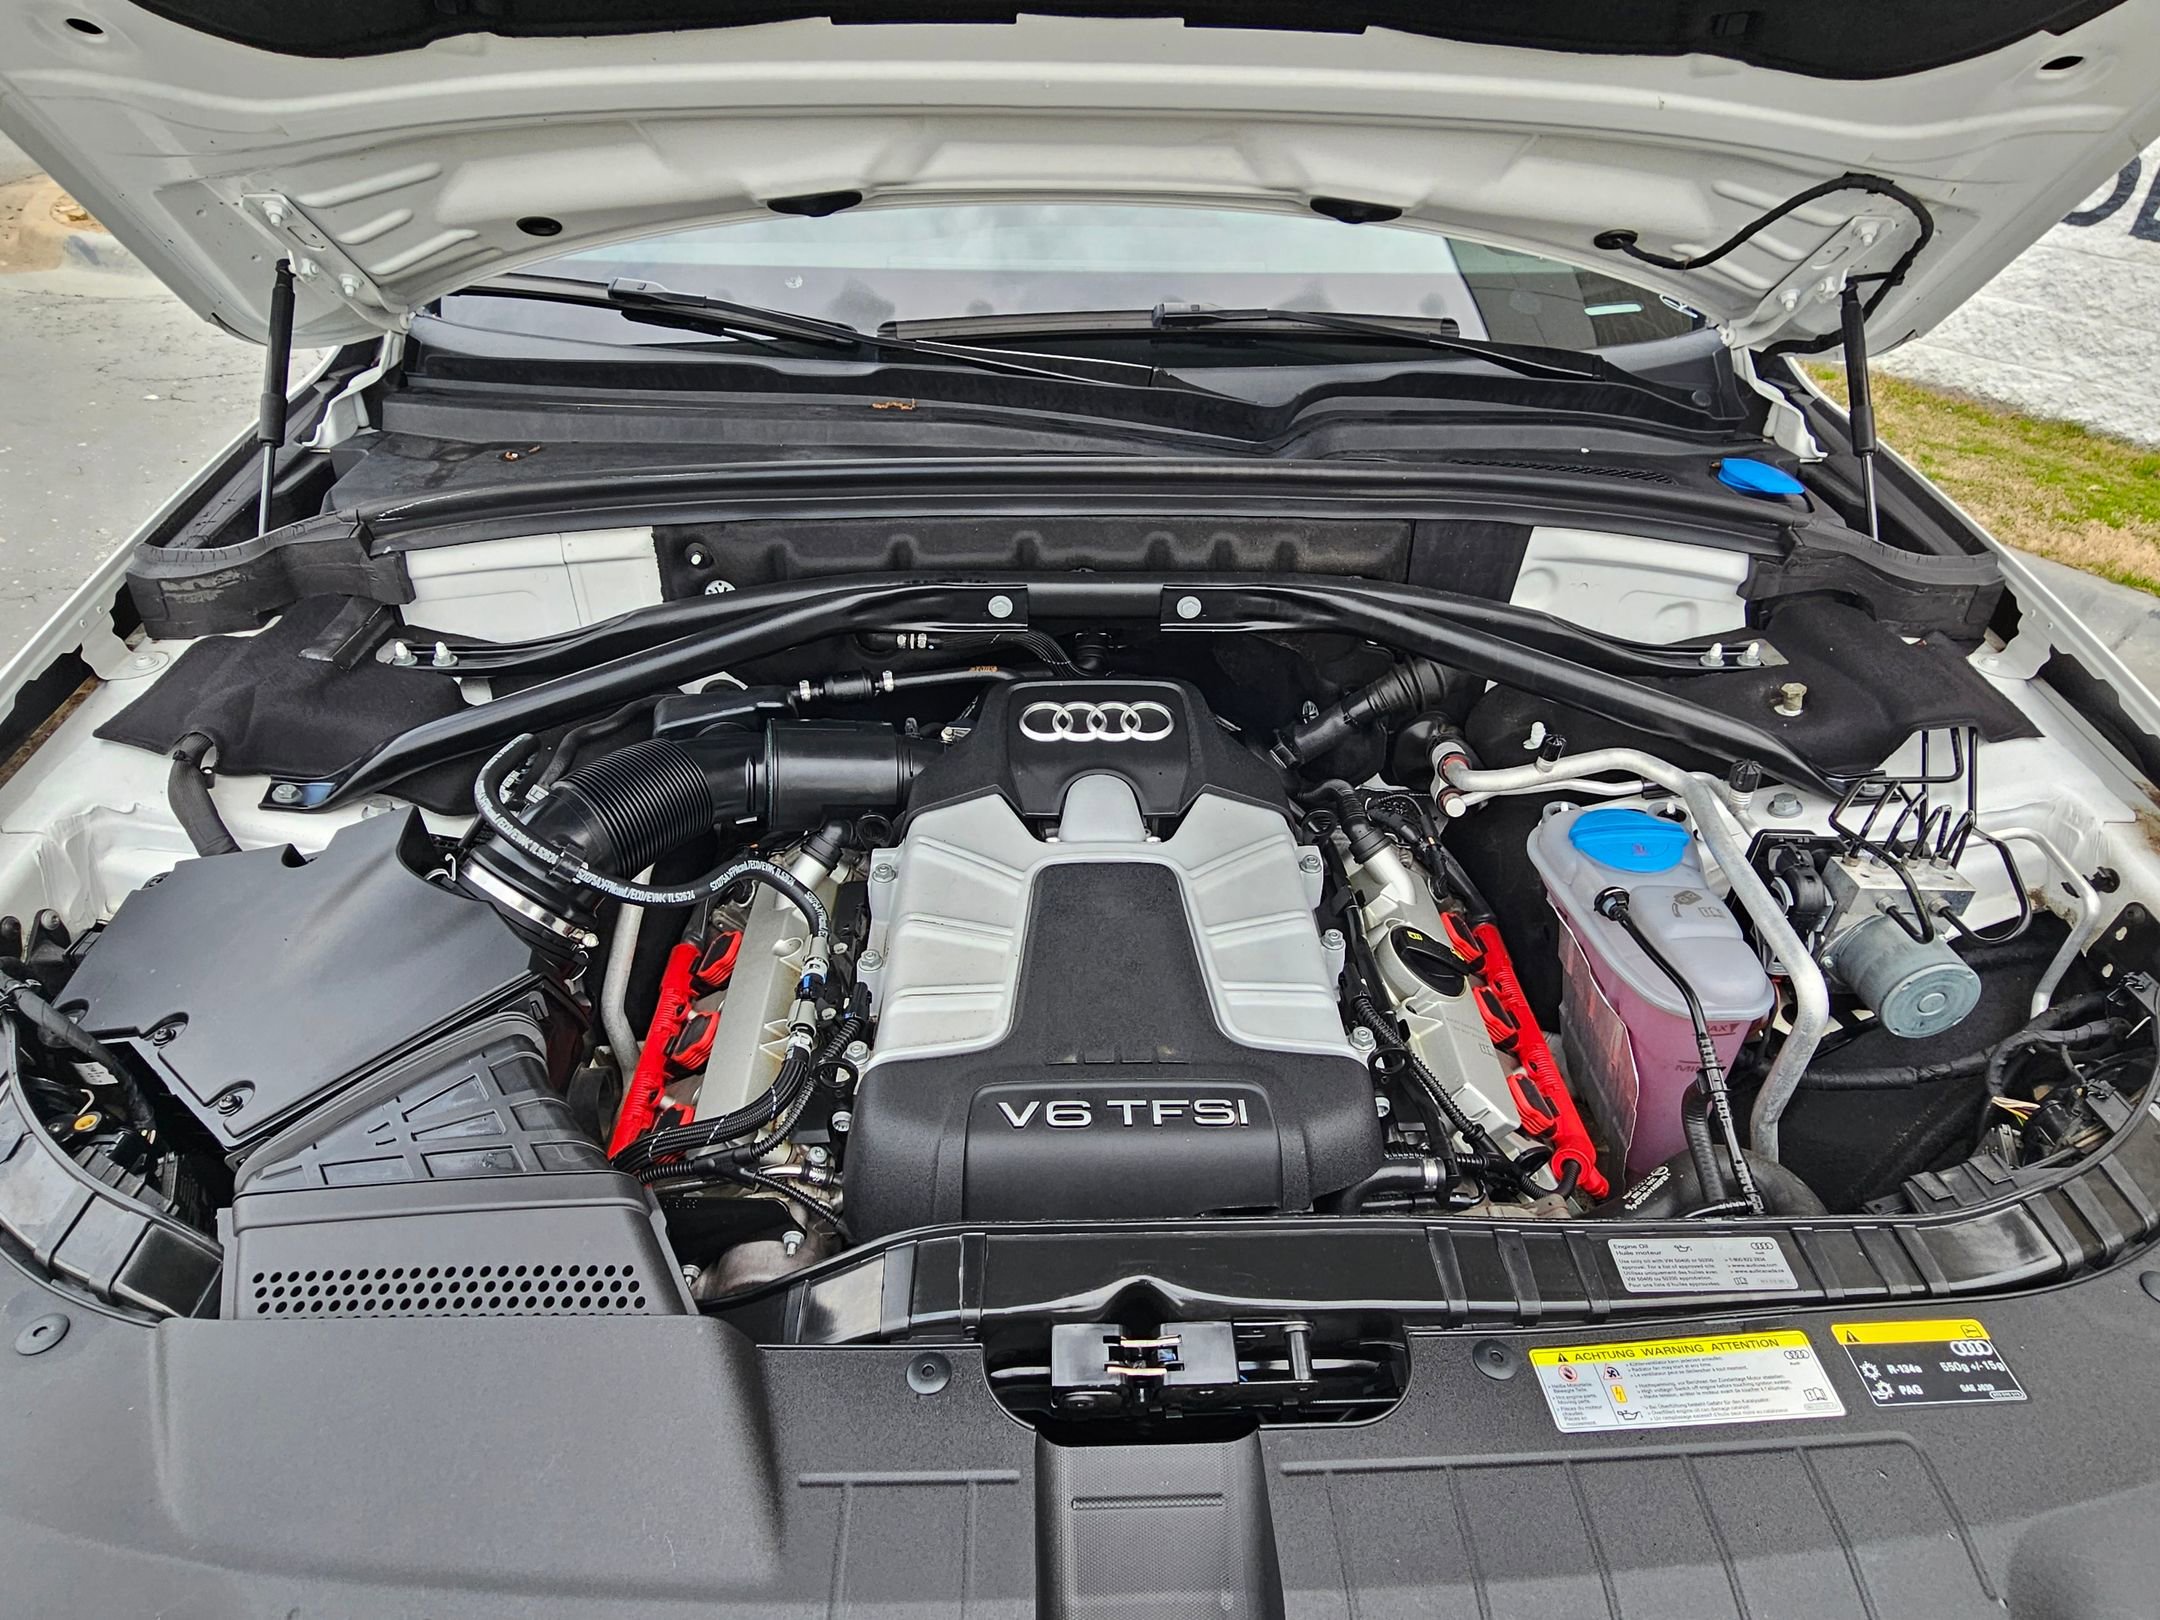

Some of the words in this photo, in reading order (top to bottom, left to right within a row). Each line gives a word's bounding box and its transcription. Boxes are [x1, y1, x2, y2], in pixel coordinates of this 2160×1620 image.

[997, 1100, 1092, 1128] V6
[1106, 1099, 1249, 1127] TFSI
[1575, 1349, 1635, 1361] ACHTUNG
[1640, 1344, 1704, 1356] WARNING
[1711, 1339, 1779, 1351] ATTENTION
[1886, 1364, 1923, 1375] R-134a
[1939, 1361, 1971, 1374] 550g
[1898, 1384, 1924, 1396] PAG
